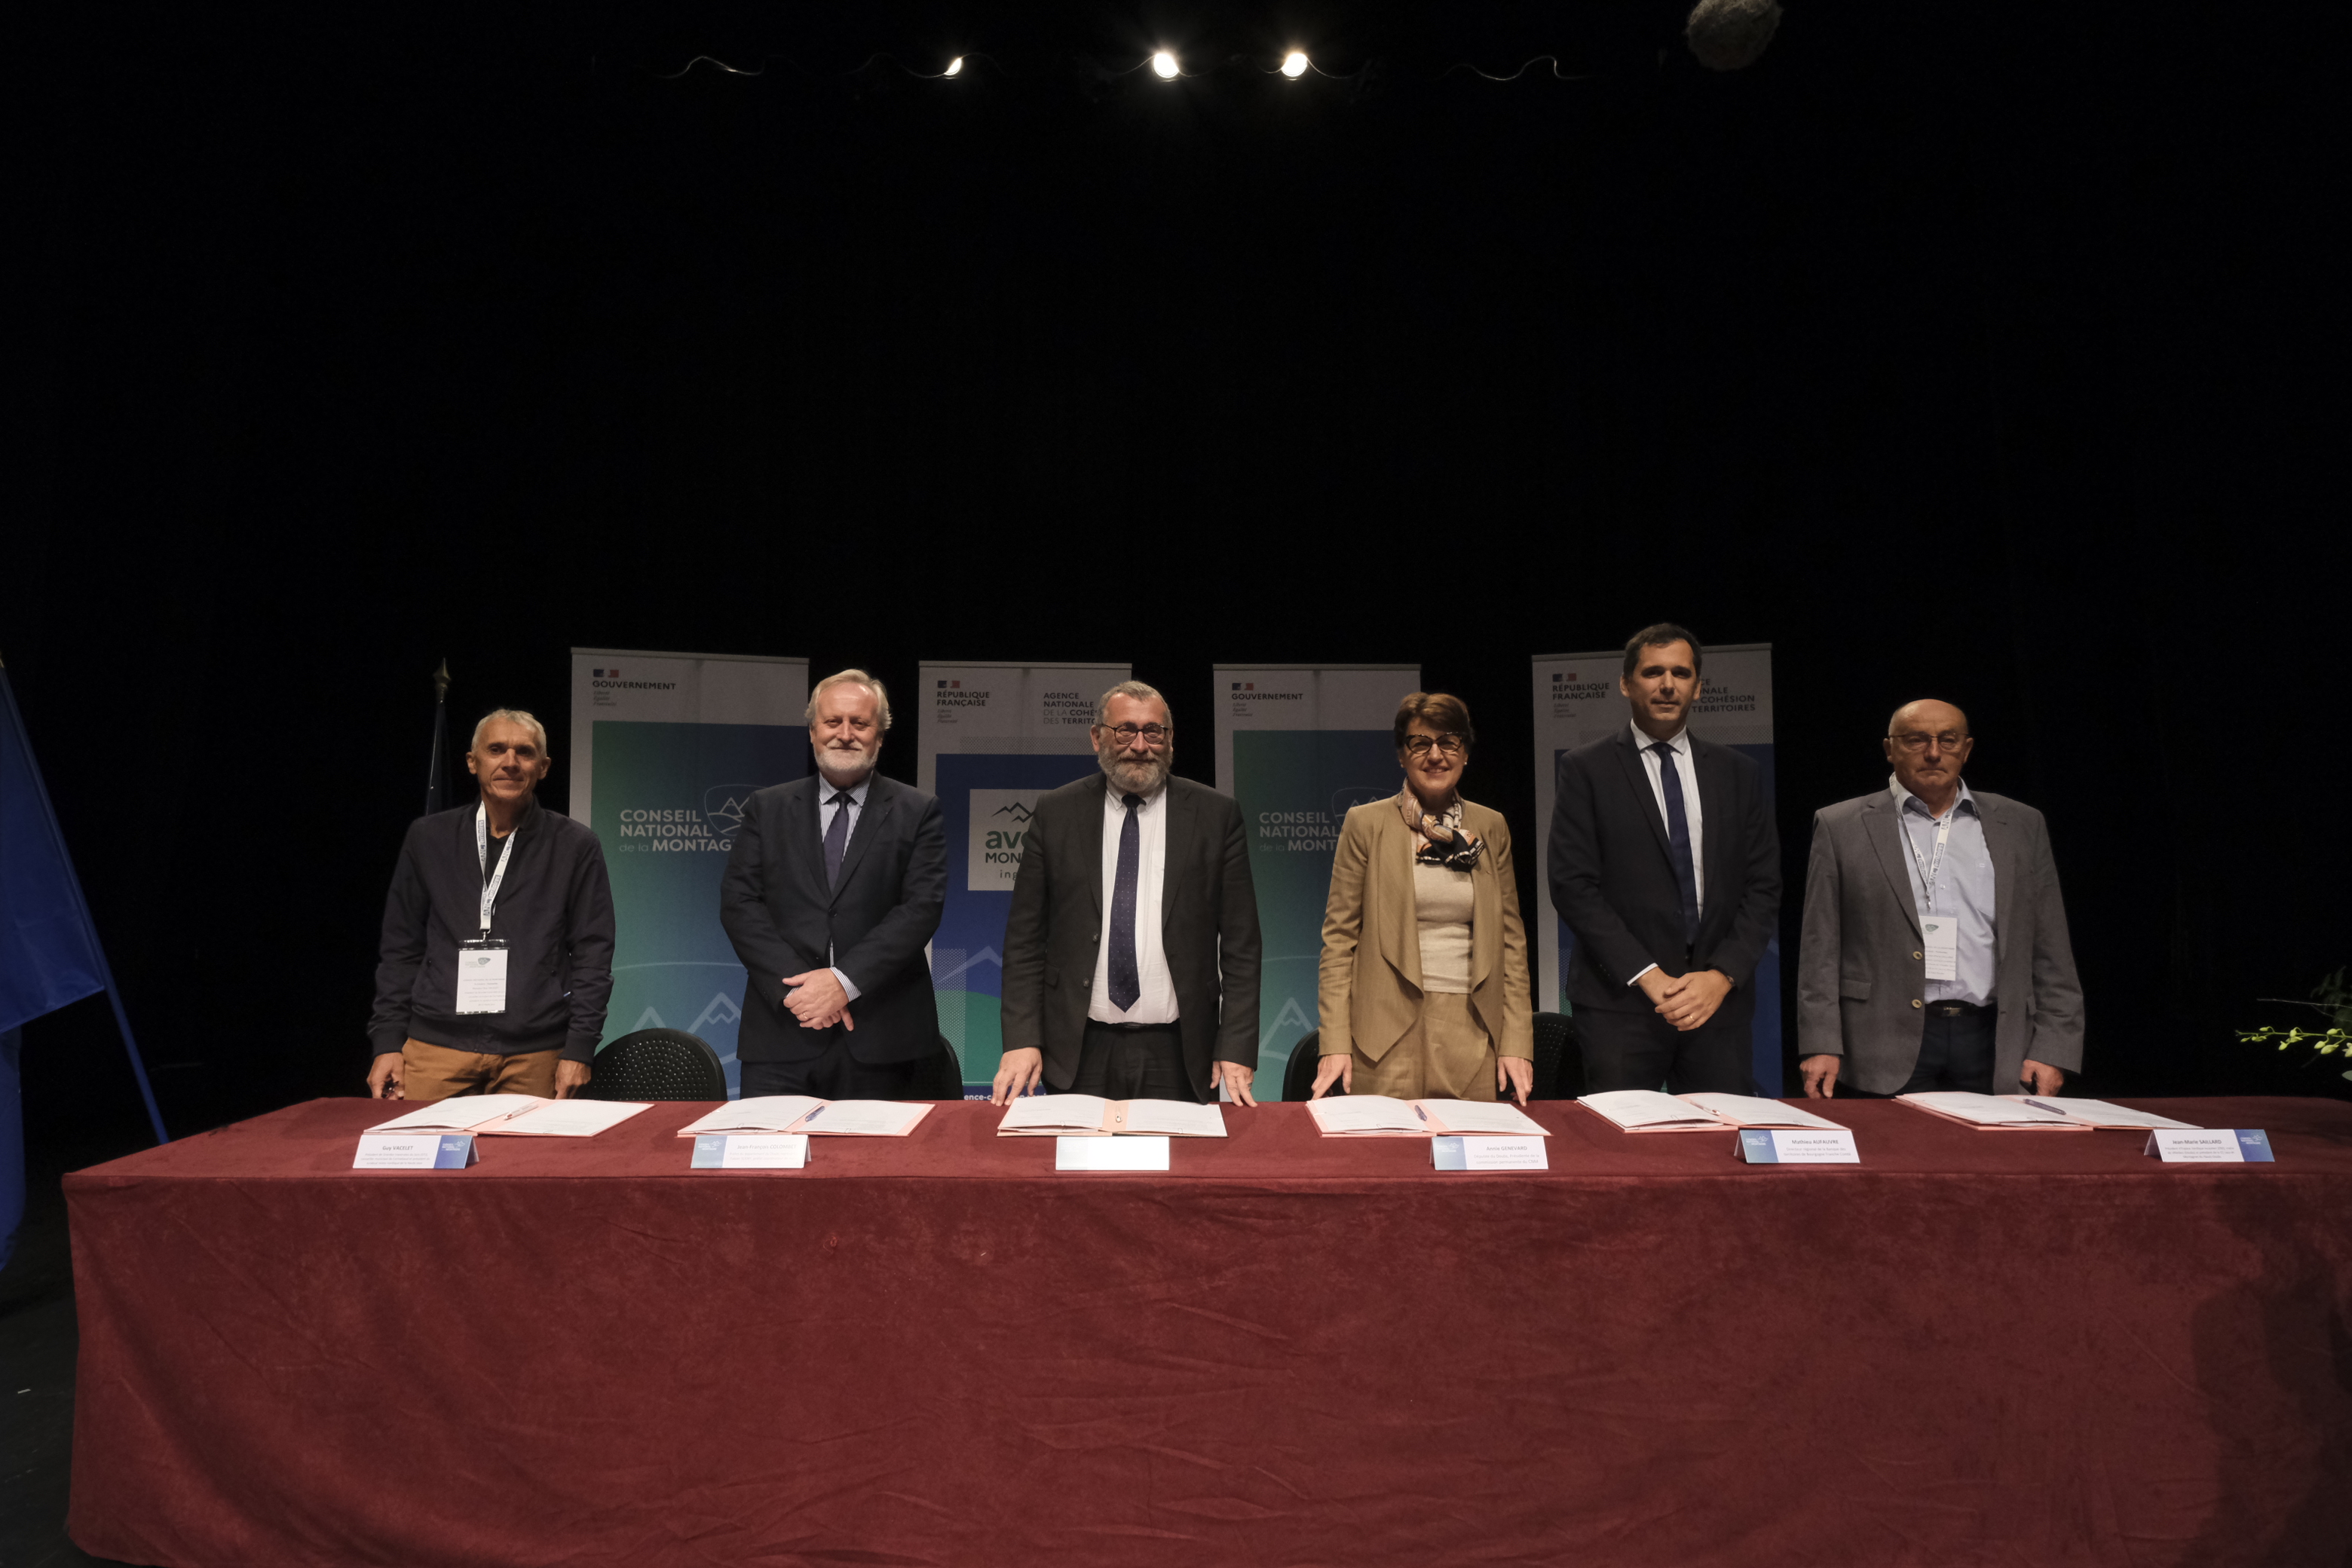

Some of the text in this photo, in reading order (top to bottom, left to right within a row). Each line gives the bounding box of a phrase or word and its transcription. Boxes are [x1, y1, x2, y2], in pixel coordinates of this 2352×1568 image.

[593, 681, 676, 690] GOUVERNEMENT
[1553, 682, 1610, 692] RÉPUBLIQUE
[937, 690, 990, 699] RÉPUBLIQUE
[1553, 691, 1606, 700] FRANÇAISE
[1701, 694, 1755, 703] COHÉSION
[1692, 703, 1755, 712] TERRITOIRES
[620, 809, 702, 822] CONSEIL
[1259, 812, 1330, 824] CONSEIL
[620, 824, 712, 837] NATIONAL
[1260, 825, 1340, 838] NATIONAL
[619, 839, 734, 853] de la MONTAG
[1259, 843, 1272, 852] de
[1276, 843, 1285, 852] la
